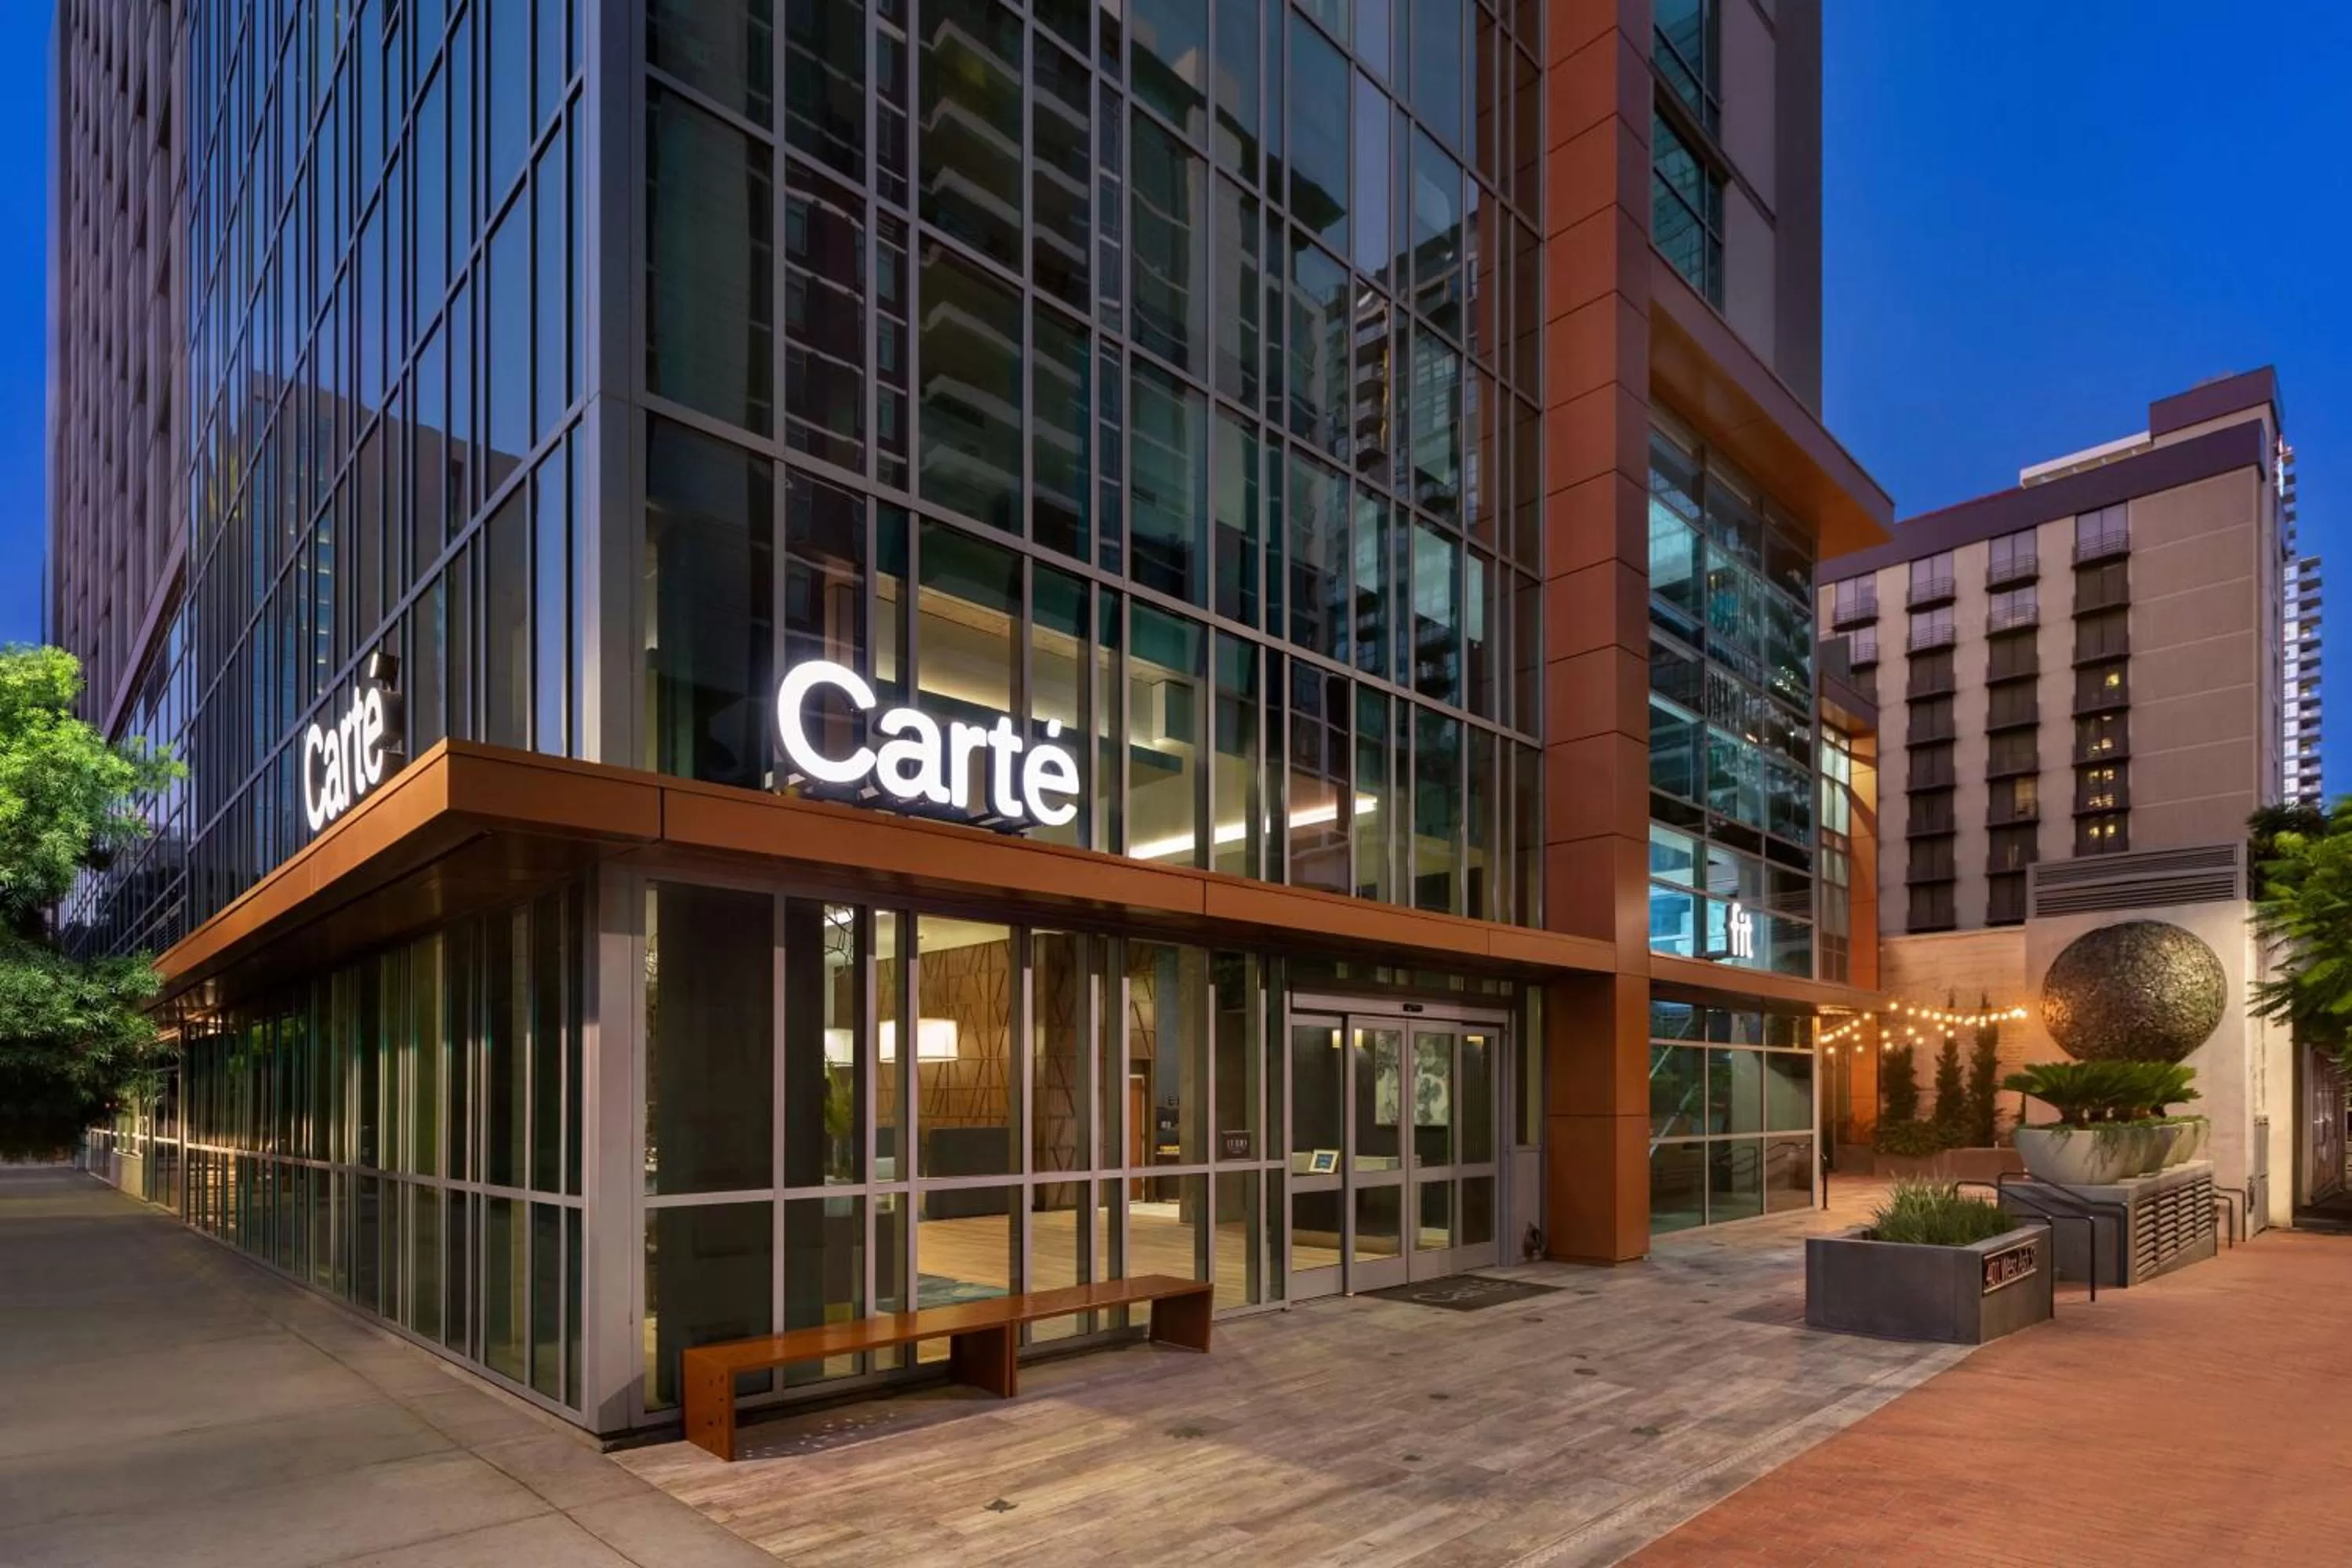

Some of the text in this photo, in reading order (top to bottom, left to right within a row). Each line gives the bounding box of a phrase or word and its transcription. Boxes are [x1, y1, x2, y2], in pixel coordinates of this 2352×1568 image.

[303, 653, 383, 830] Carté
[777, 659, 1080, 826] Carté
[1730, 902, 1754, 959] fit
